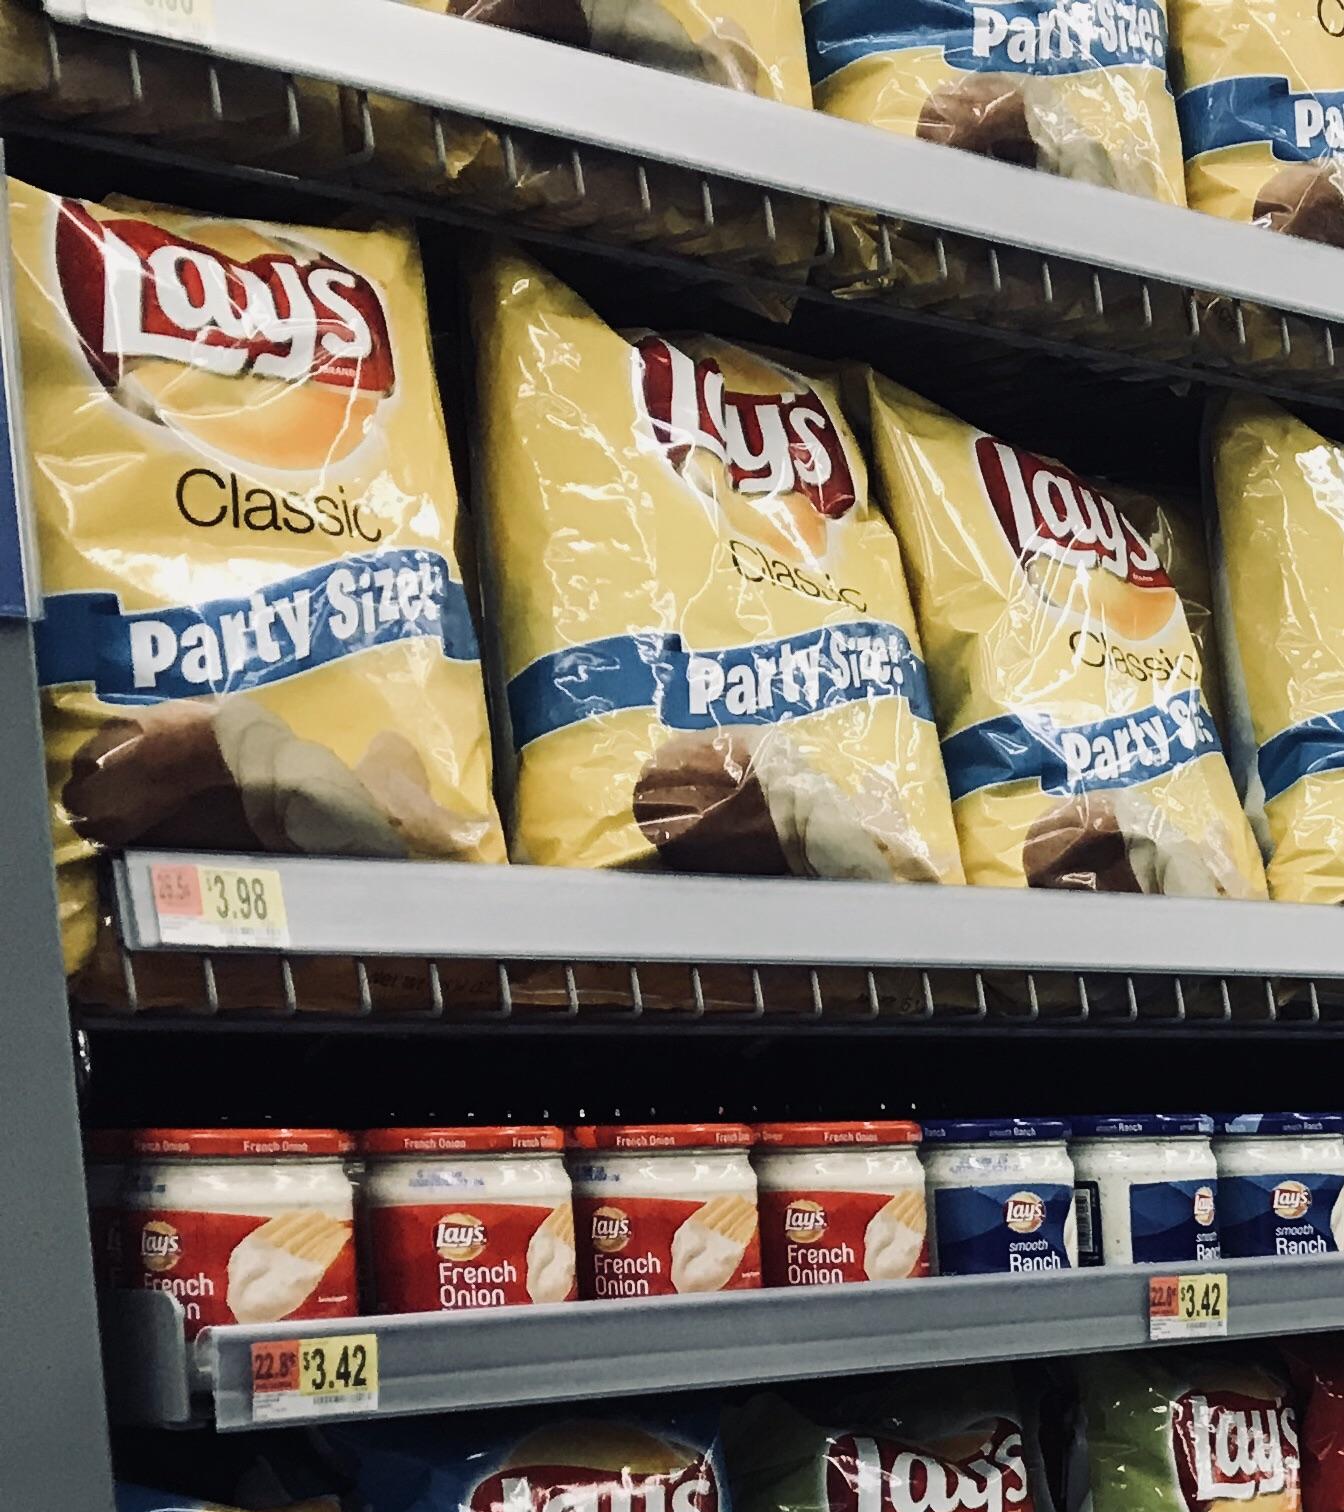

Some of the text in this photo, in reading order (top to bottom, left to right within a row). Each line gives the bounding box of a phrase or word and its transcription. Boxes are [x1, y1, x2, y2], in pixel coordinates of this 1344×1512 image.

[176, 468, 382, 543] Classic
[130, 561, 443, 688] Party Size!
[1068, 631, 1198, 683] Classic
[688, 632, 903, 715] Party Size!
[1063, 717, 1168, 783] Party
[404, 1139, 435, 1149] French
[616, 1137, 646, 1146] French
[824, 1132, 849, 1141] French
[1275, 1226, 1314, 1236] smooth
[788, 1243, 854, 1264] French
[1009, 1240, 1048, 1252] smooth
[1276, 1235, 1326, 1255] Ranch
[595, 1253, 660, 1275] French
[1011, 1251, 1060, 1272] Ranch
[439, 1261, 516, 1284] French
[789, 1265, 842, 1284] Onion
[440, 1286, 504, 1306] Onion
[596, 1276, 648, 1295] Onion
[1181, 1283, 1221, 1318] $3.42
[303, 1345, 367, 1390] $3.42
